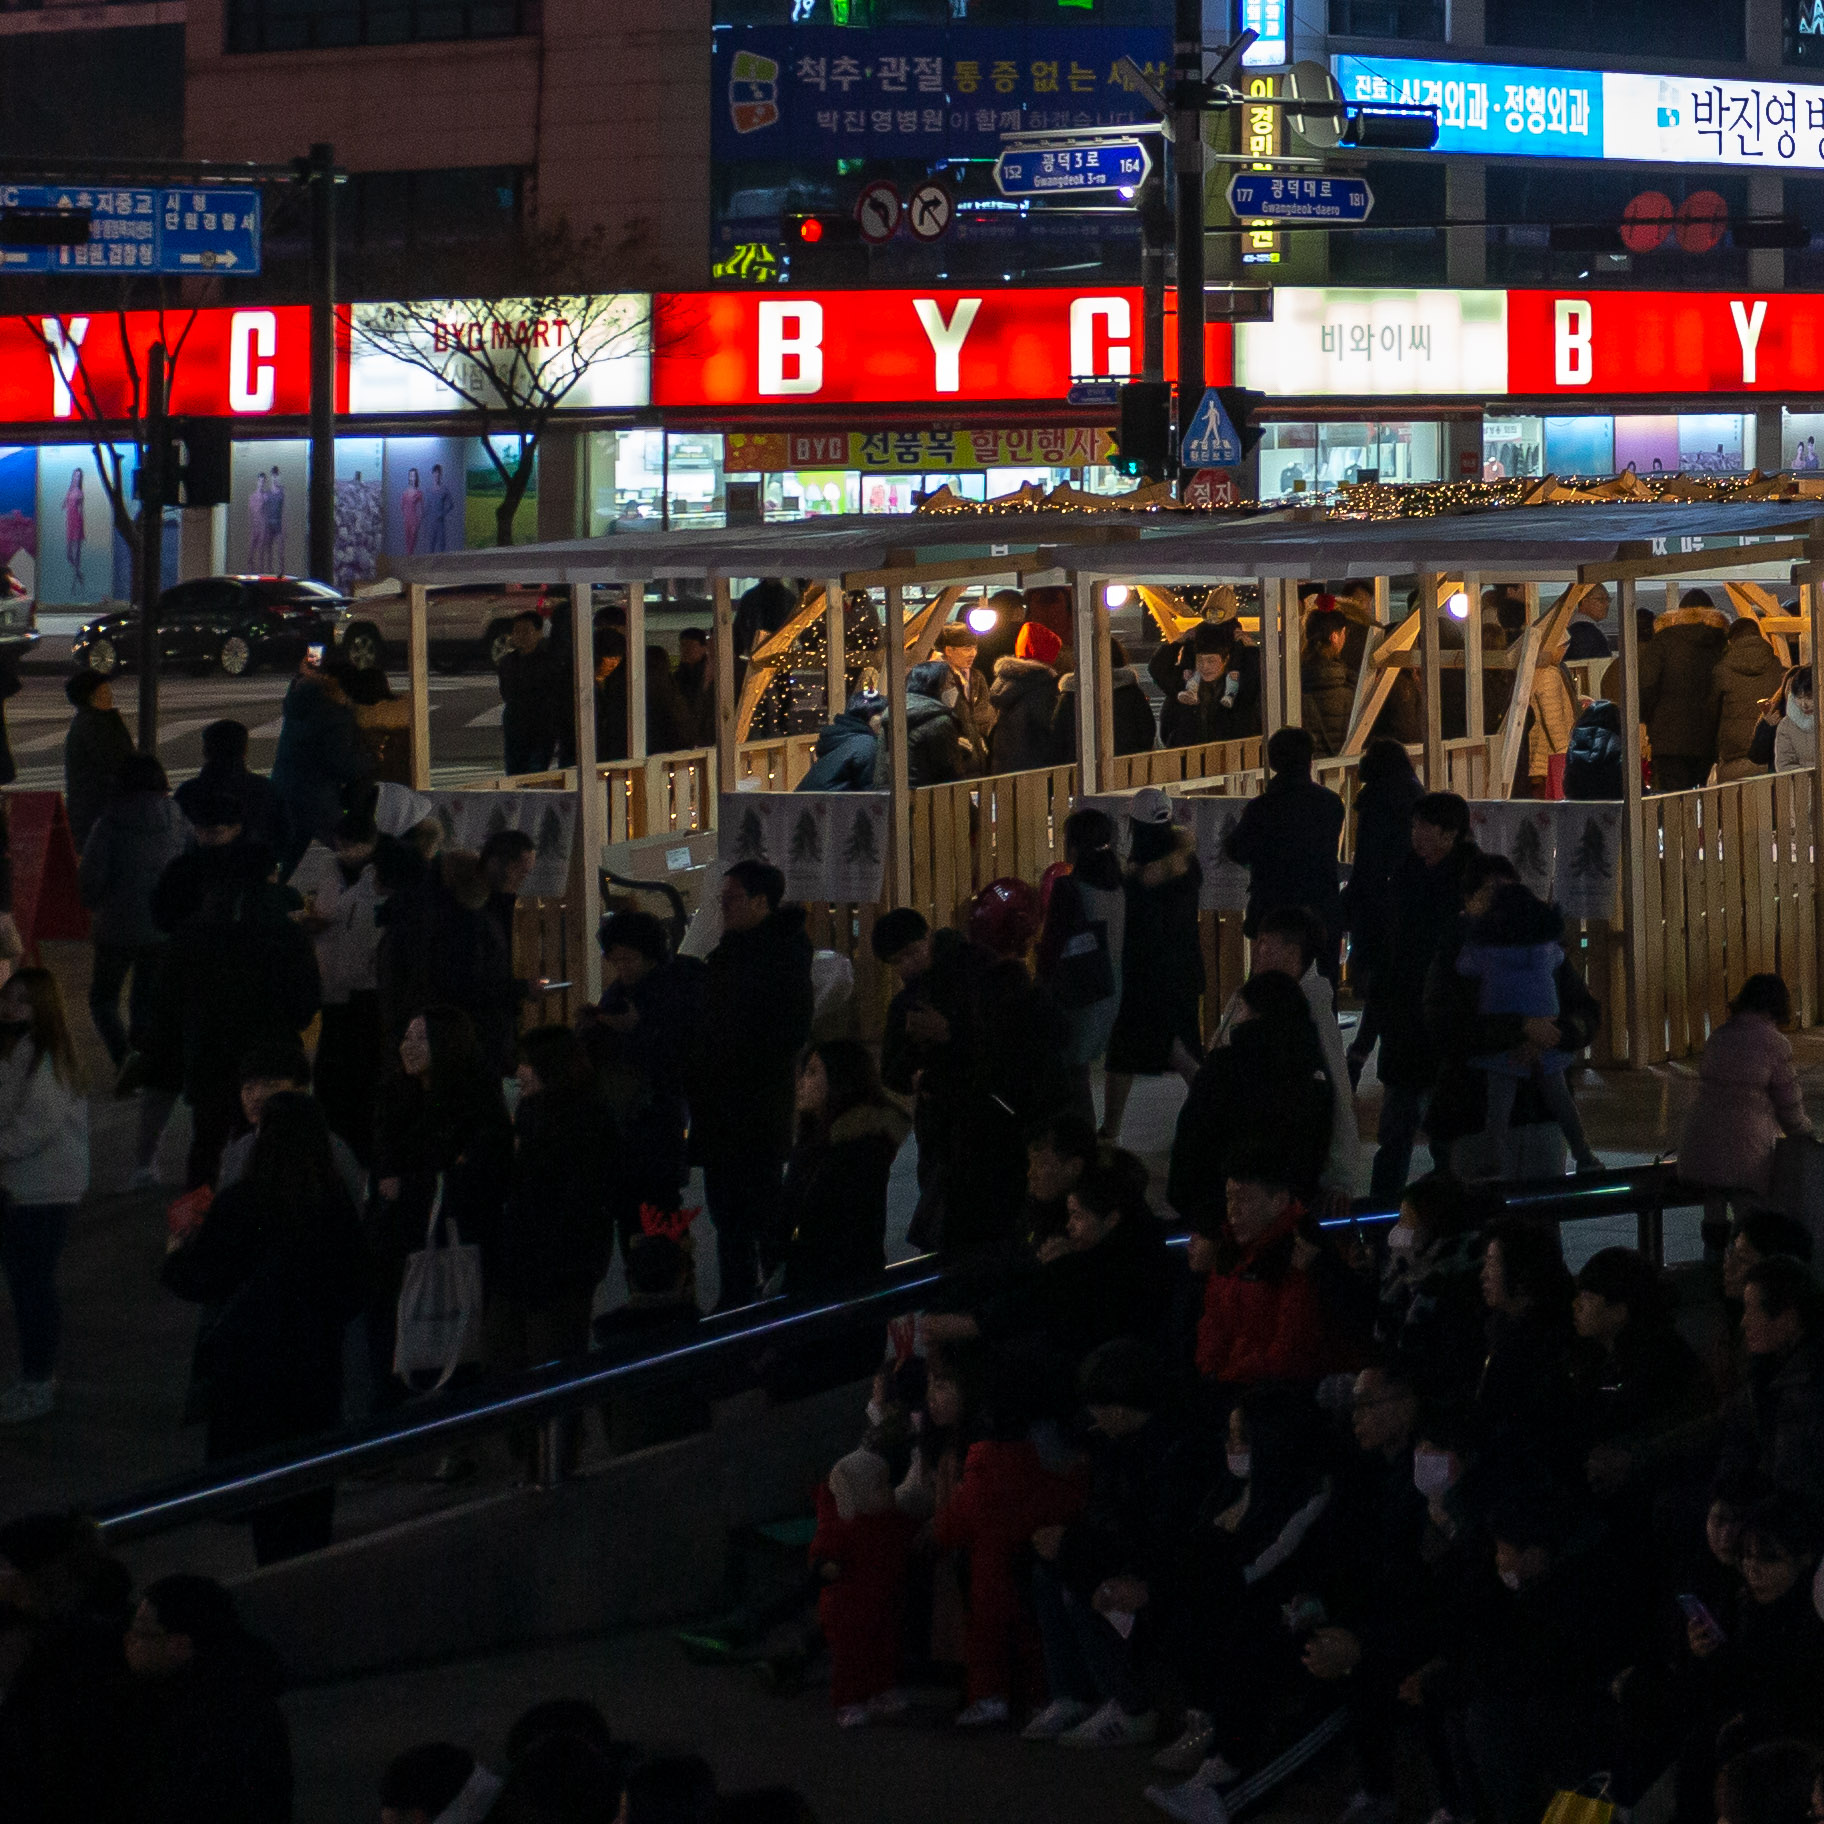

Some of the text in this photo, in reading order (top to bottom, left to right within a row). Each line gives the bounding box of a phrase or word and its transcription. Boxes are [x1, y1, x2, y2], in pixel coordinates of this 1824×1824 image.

[1119, 158, 1141, 175] 164
[1236, 188, 1254, 203] 177
[1270, 179, 1334, 199] 광덕대로
[491, 318, 569, 349] MART
[756, 296, 1132, 396] BYC
[1321, 322, 1433, 361] 비와이씨
[1192, 480, 1234, 504] 정지
